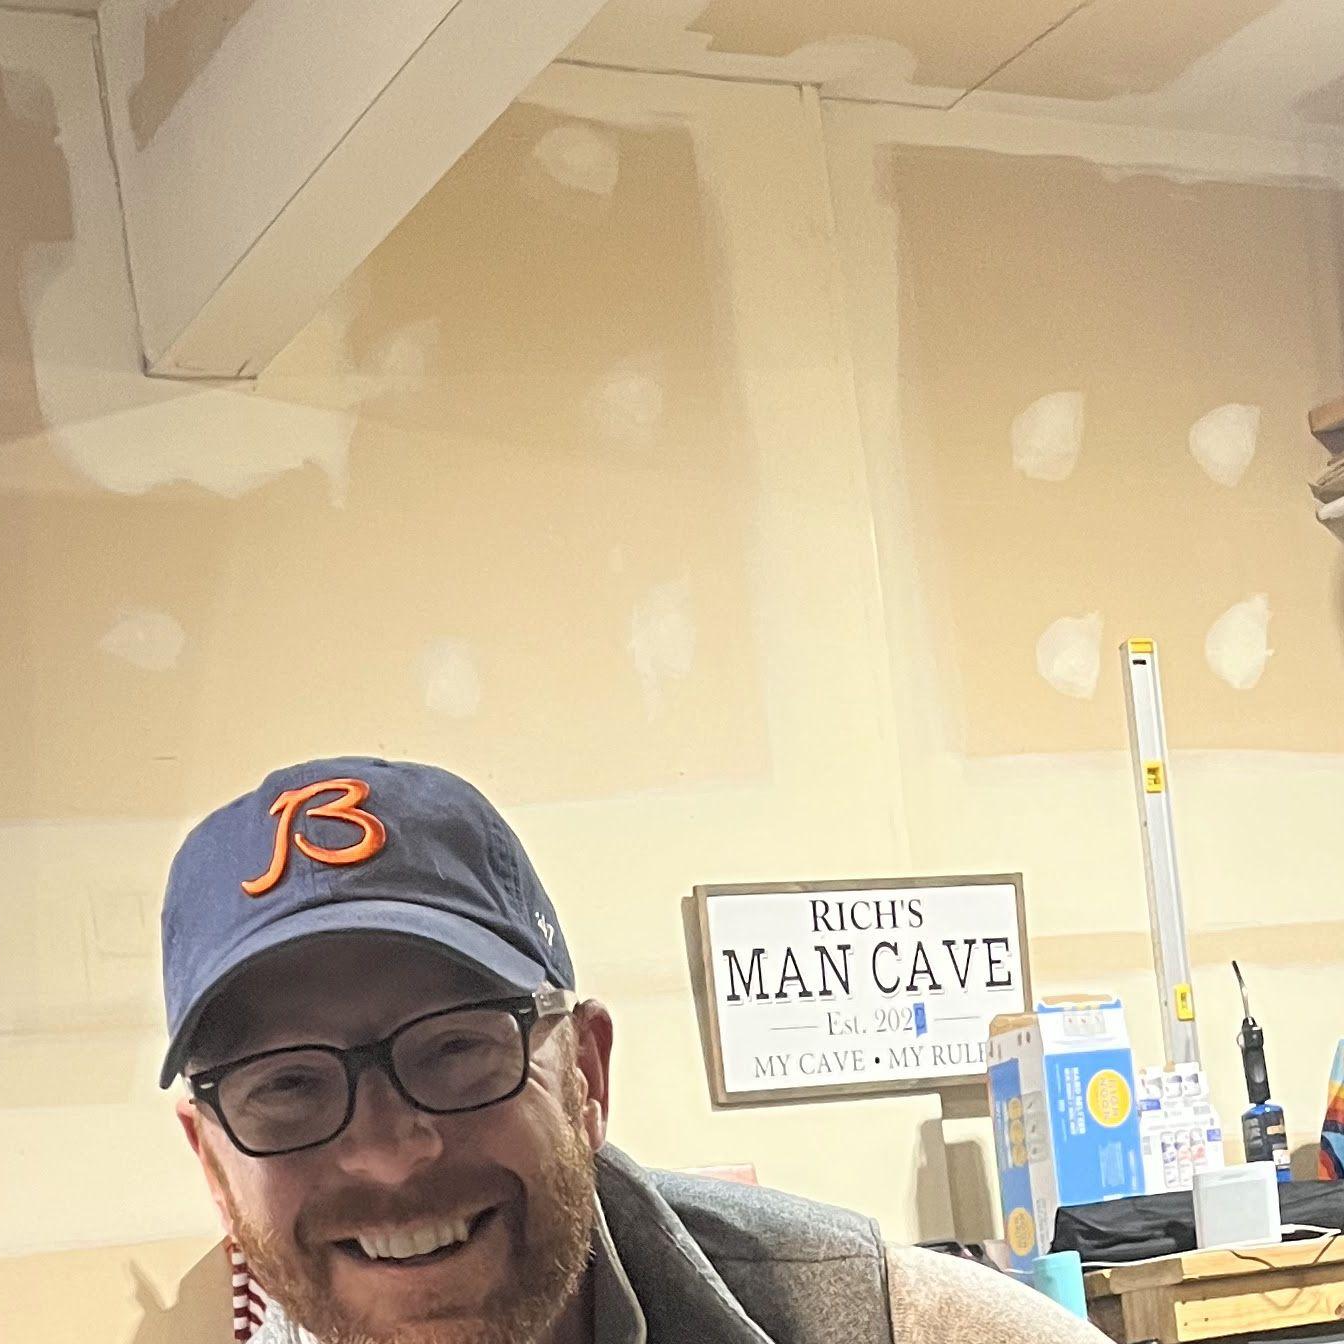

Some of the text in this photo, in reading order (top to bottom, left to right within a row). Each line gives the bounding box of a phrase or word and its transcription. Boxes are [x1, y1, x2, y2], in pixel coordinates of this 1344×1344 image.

[240, 778, 385, 895] B
[809, 899, 924, 932] RICH'S
[722, 937, 1012, 1002] MAN CAVE
[827, 1011, 867, 1036] Est.
[753, 1041, 987, 1078] MY CAVE MY RULE
